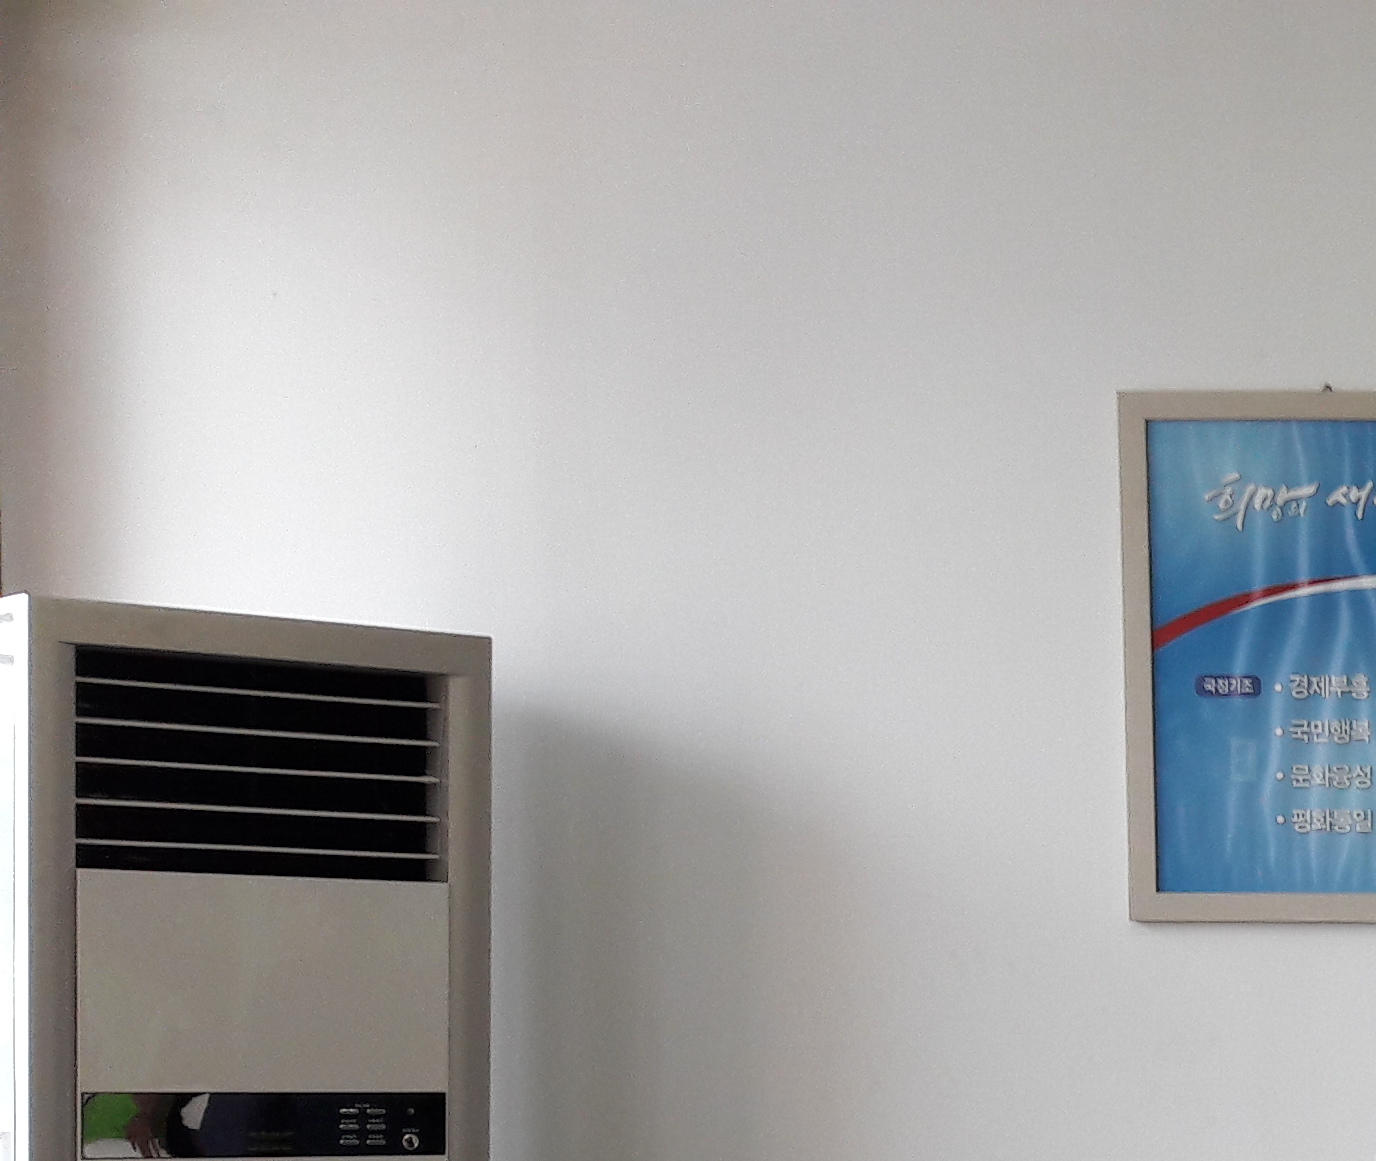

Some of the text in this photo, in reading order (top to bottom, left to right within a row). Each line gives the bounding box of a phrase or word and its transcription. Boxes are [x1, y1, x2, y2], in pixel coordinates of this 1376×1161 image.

[1289, 674, 1371, 700] 경제부흥
[1288, 718, 1371, 745] 국민행복
[1290, 764, 1374, 789] 문화융성
[1291, 809, 1373, 833] 평화통일
